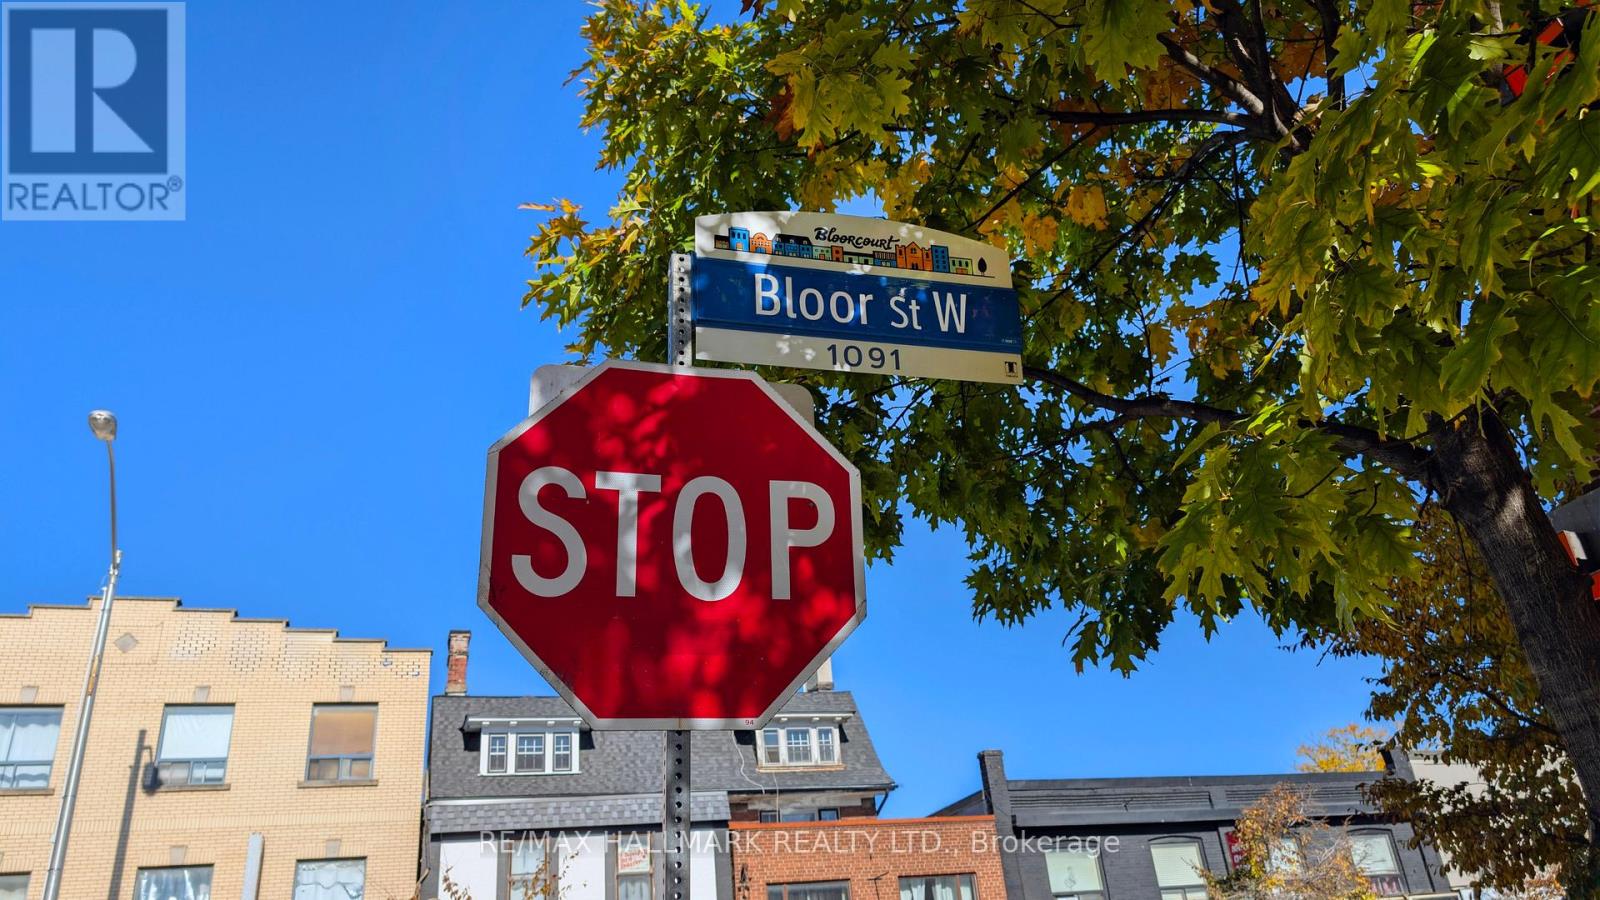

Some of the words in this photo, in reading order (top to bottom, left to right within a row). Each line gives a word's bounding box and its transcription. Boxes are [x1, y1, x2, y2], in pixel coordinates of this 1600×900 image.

[814, 226, 900, 250] Bloorcourt
[754, 273, 874, 325] Bloor
[890, 295, 922, 330] St
[932, 290, 967, 334] W
[827, 343, 901, 371] 1091
[511, 466, 836, 602] STOP
